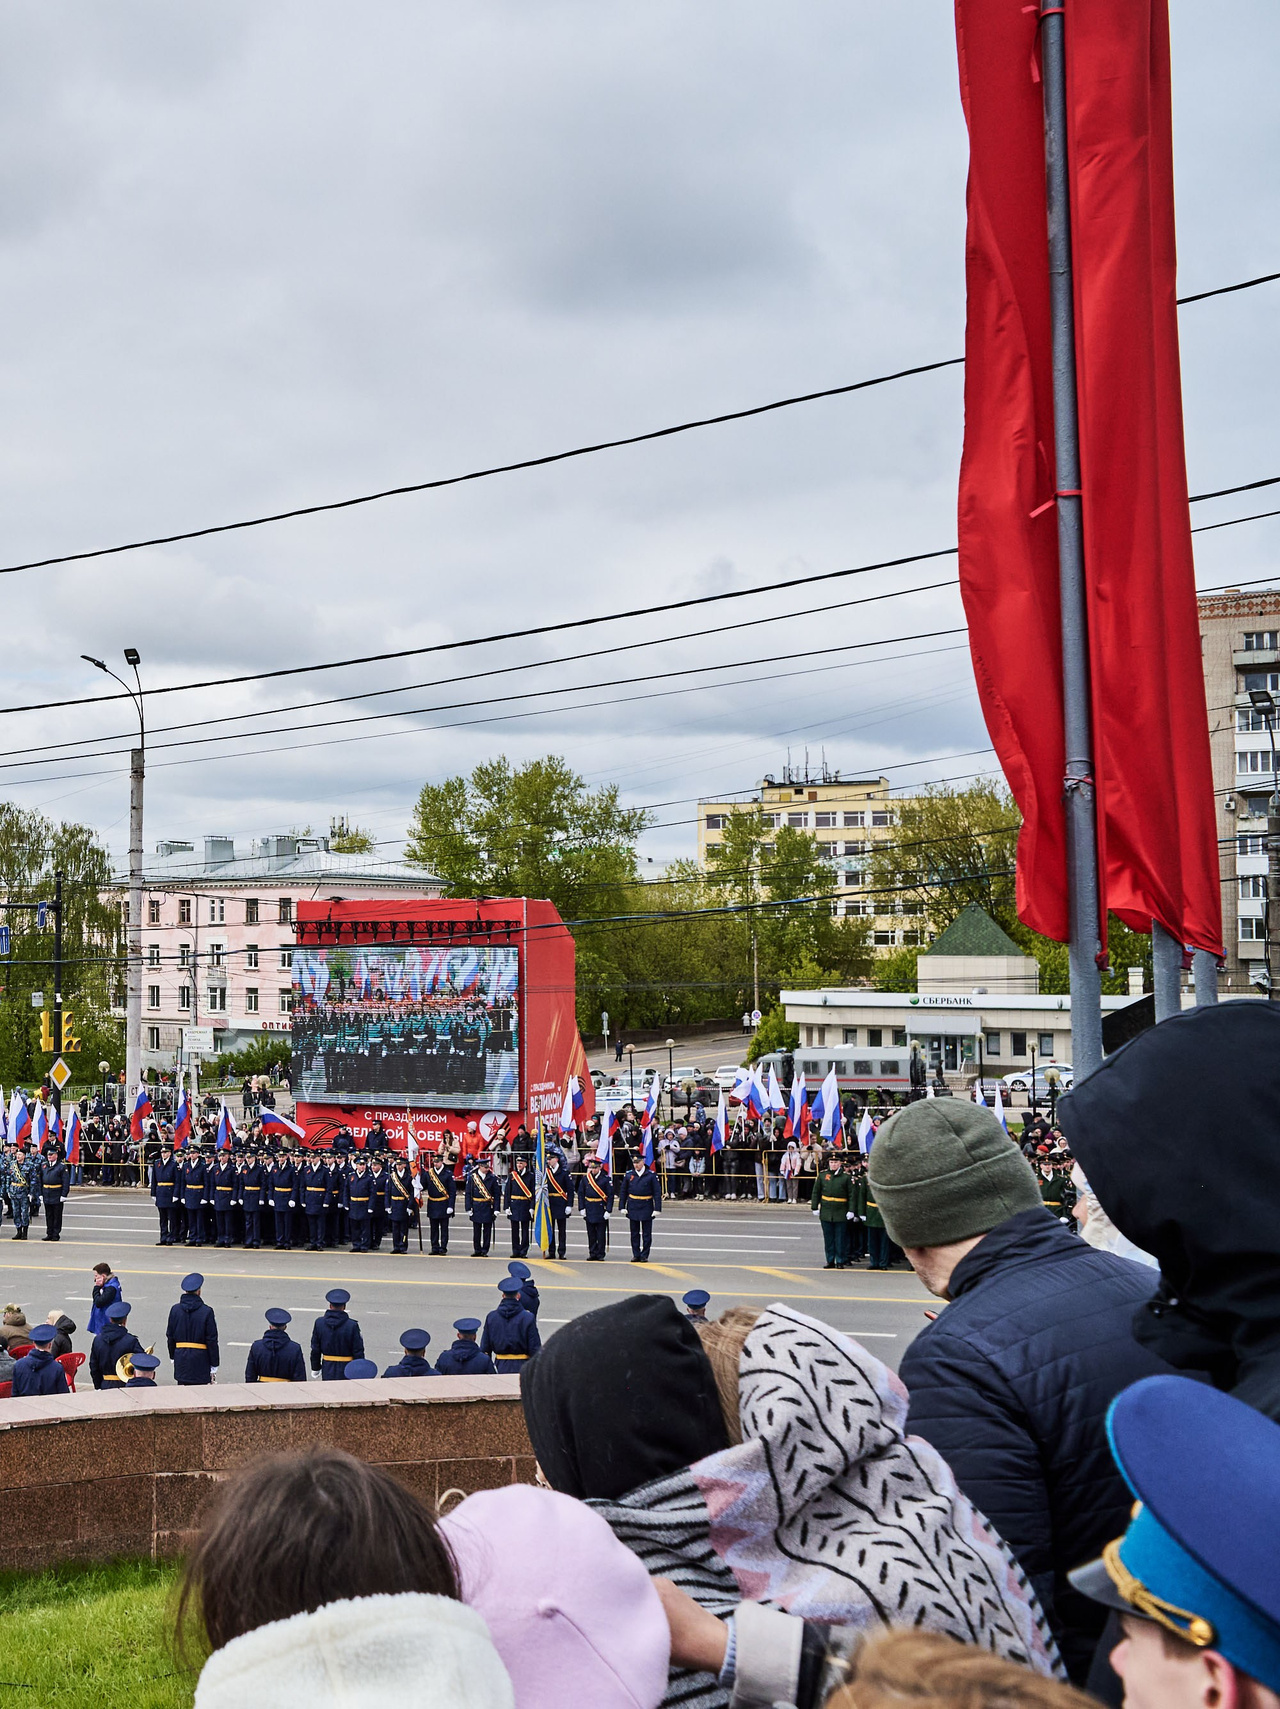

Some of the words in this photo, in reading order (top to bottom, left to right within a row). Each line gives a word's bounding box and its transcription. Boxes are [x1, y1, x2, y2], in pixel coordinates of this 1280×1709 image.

[922, 997, 972, 1005] СБЕРБАНК
[364, 1111, 372, 1120] С
[375, 1111, 447, 1123] ПРАЗДНИКОМ
[346, 1126, 404, 1140] ВЕЛОЙ
